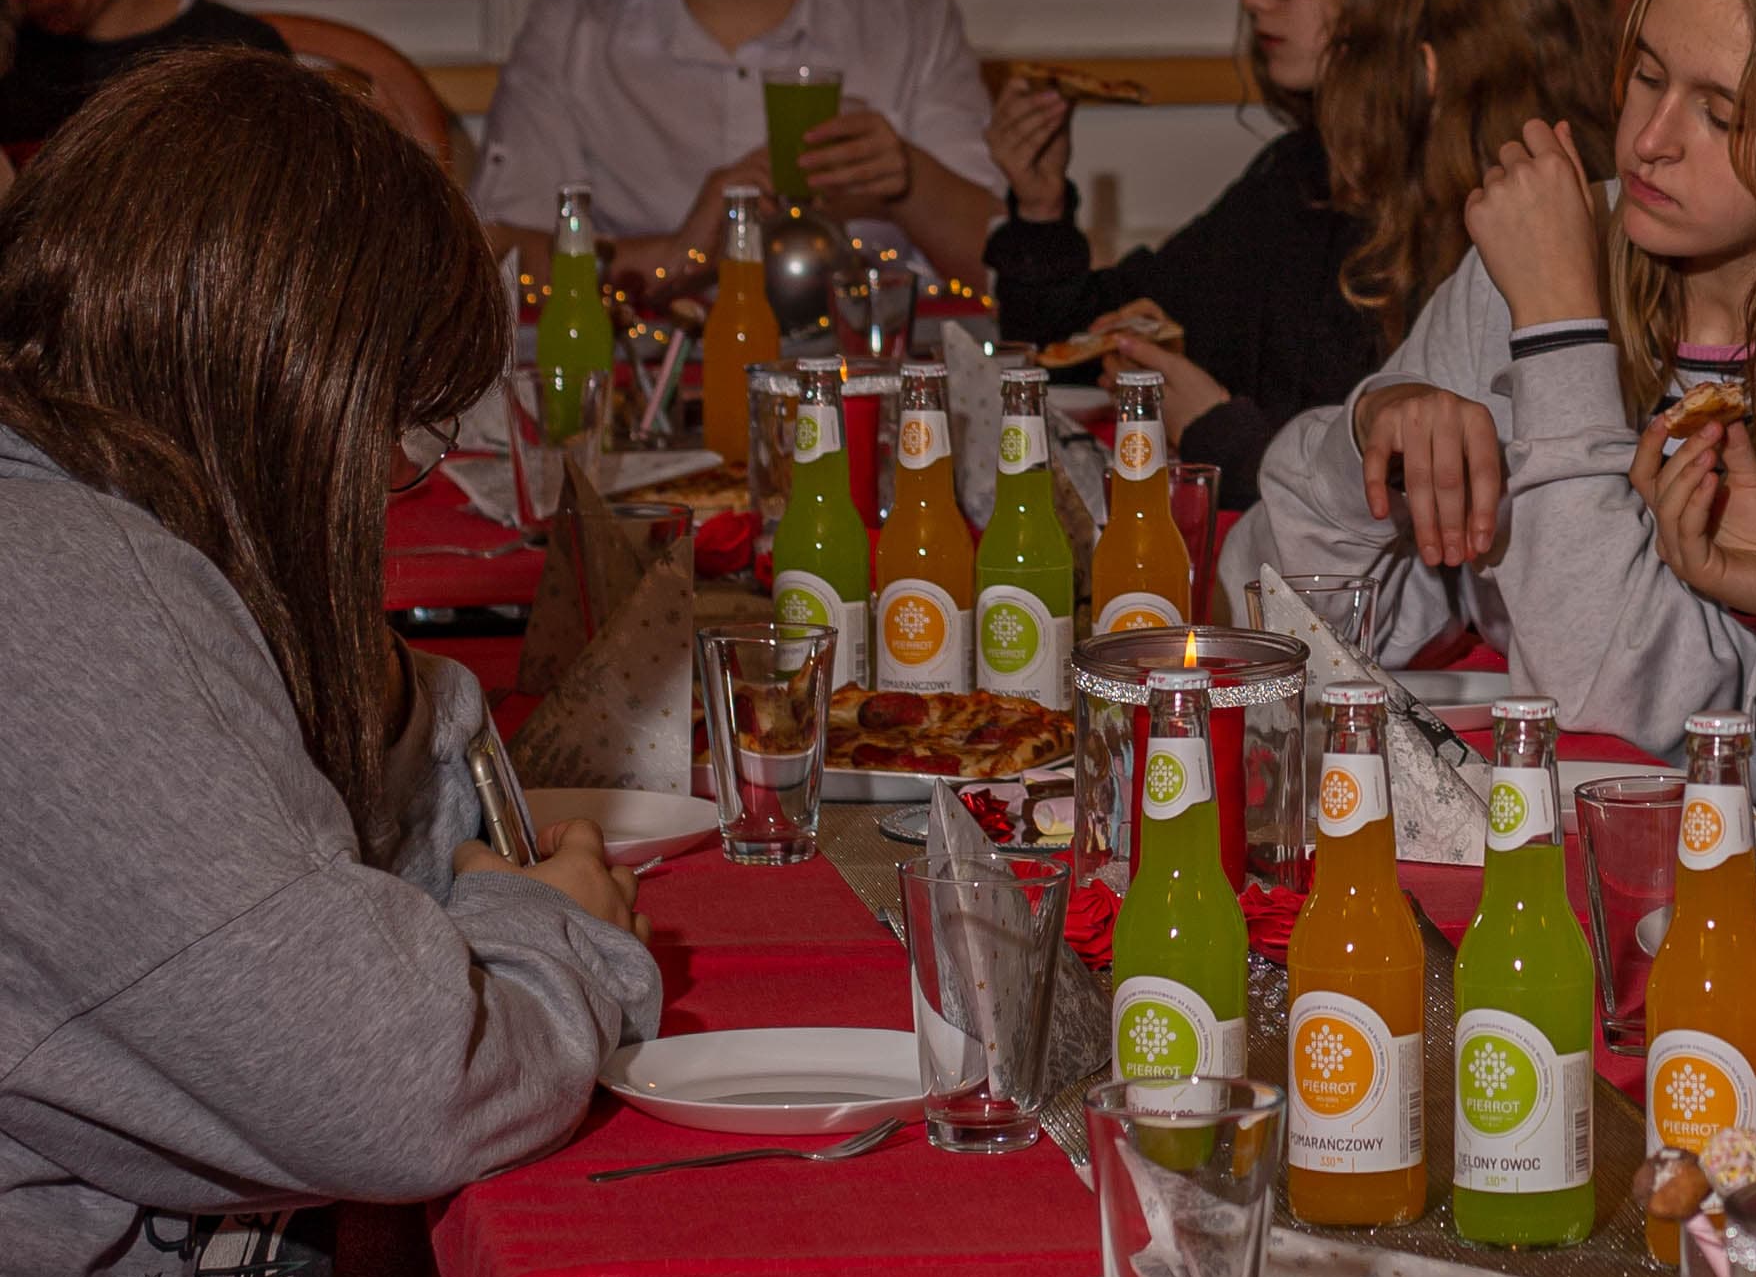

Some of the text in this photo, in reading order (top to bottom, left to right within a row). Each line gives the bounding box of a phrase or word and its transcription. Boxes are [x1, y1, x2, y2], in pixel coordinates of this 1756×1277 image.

[1126, 1061, 1182, 1077] PIERROT
[1302, 1079, 1357, 1096] PIERROT
[1467, 1098, 1520, 1114] PIERROT
[1663, 1119, 1720, 1136] PIERROT
[1290, 1131, 1383, 1152] POMARAŃCZOWY
[1501, 1157, 1541, 1172] OWOC
